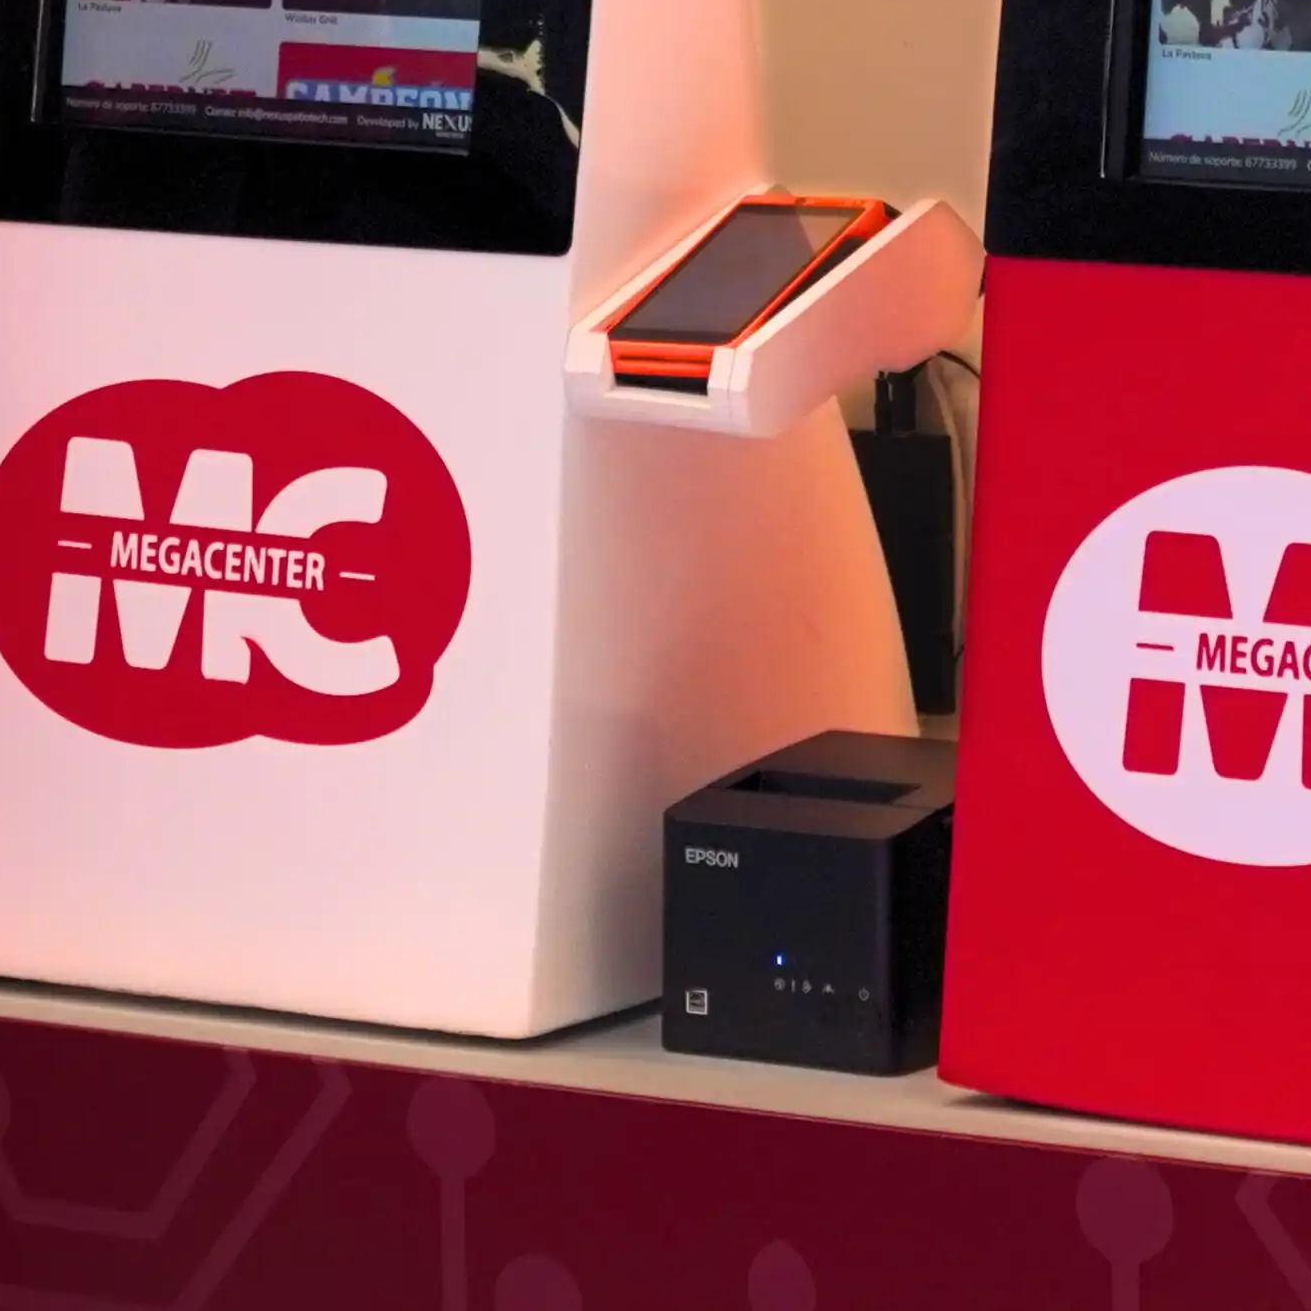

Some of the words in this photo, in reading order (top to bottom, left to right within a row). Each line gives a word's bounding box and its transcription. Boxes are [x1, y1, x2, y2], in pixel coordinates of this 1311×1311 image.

[44, 436, 400, 696] MC
[110, 531, 326, 590] MEGACENTER
[685, 848, 738, 868] EPSON
